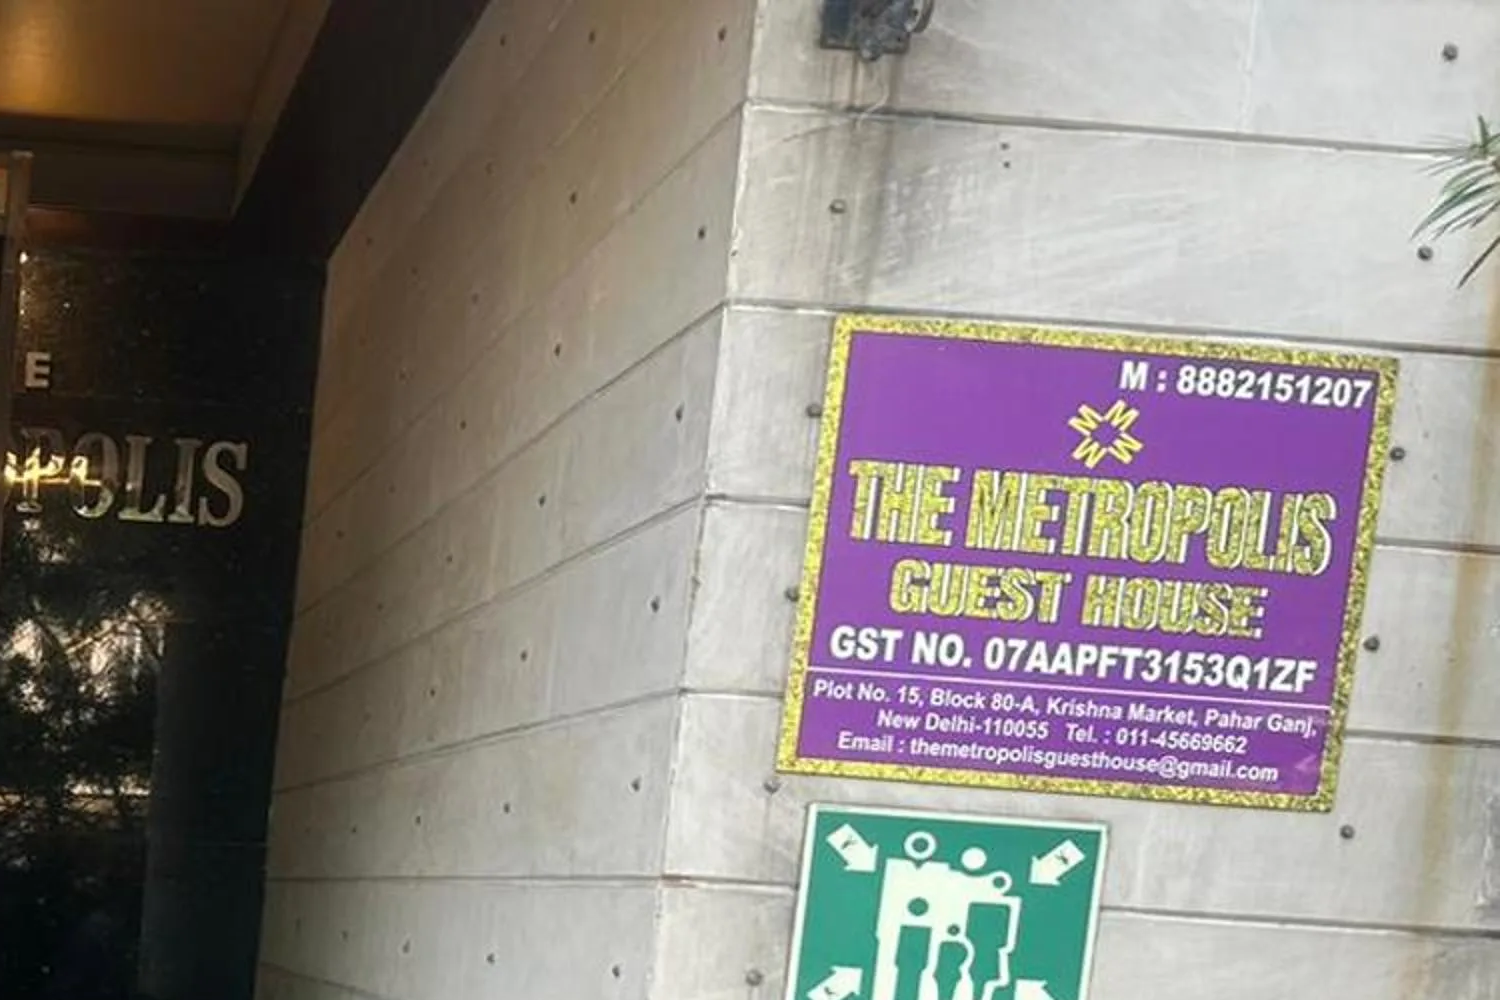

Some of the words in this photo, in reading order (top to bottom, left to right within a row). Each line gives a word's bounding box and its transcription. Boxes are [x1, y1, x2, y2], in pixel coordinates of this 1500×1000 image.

[1119, 360, 1149, 391] M
[1175, 364, 1373, 409] 8882151207
[847, 458, 961, 548] THE
[964, 469, 1338, 577] METROPOLIS
[889, 558, 1073, 625] GUEST
[1081, 573, 1270, 639] HOUSE
[829, 625, 903, 662] GST
[911, 631, 973, 668] NO.
[983, 637, 1318, 693] 07AAPFT3153Q1ZF
[813, 679, 854, 701] Plot
[856, 683, 891, 703] No.
[897, 686, 925, 707] 15,
[929, 688, 988, 710] Block
[990, 693, 1041, 715] 80-A,
[1045, 696, 1123, 721] Krishna
[1128, 702, 1199, 728] Market,
[1204, 708, 1263, 732] Pahar
[1267, 713, 1318, 738] Ganj,
[877, 709, 920, 730] New
[924, 712, 1050, 740] Delhi-110055
[1066, 723, 1098, 744] Tel.
[1115, 727, 1249, 755] 011-45669662
[837, 731, 894, 752] Email
[910, 738, 1279, 783] themetropolisguesthouse@gmail.com
